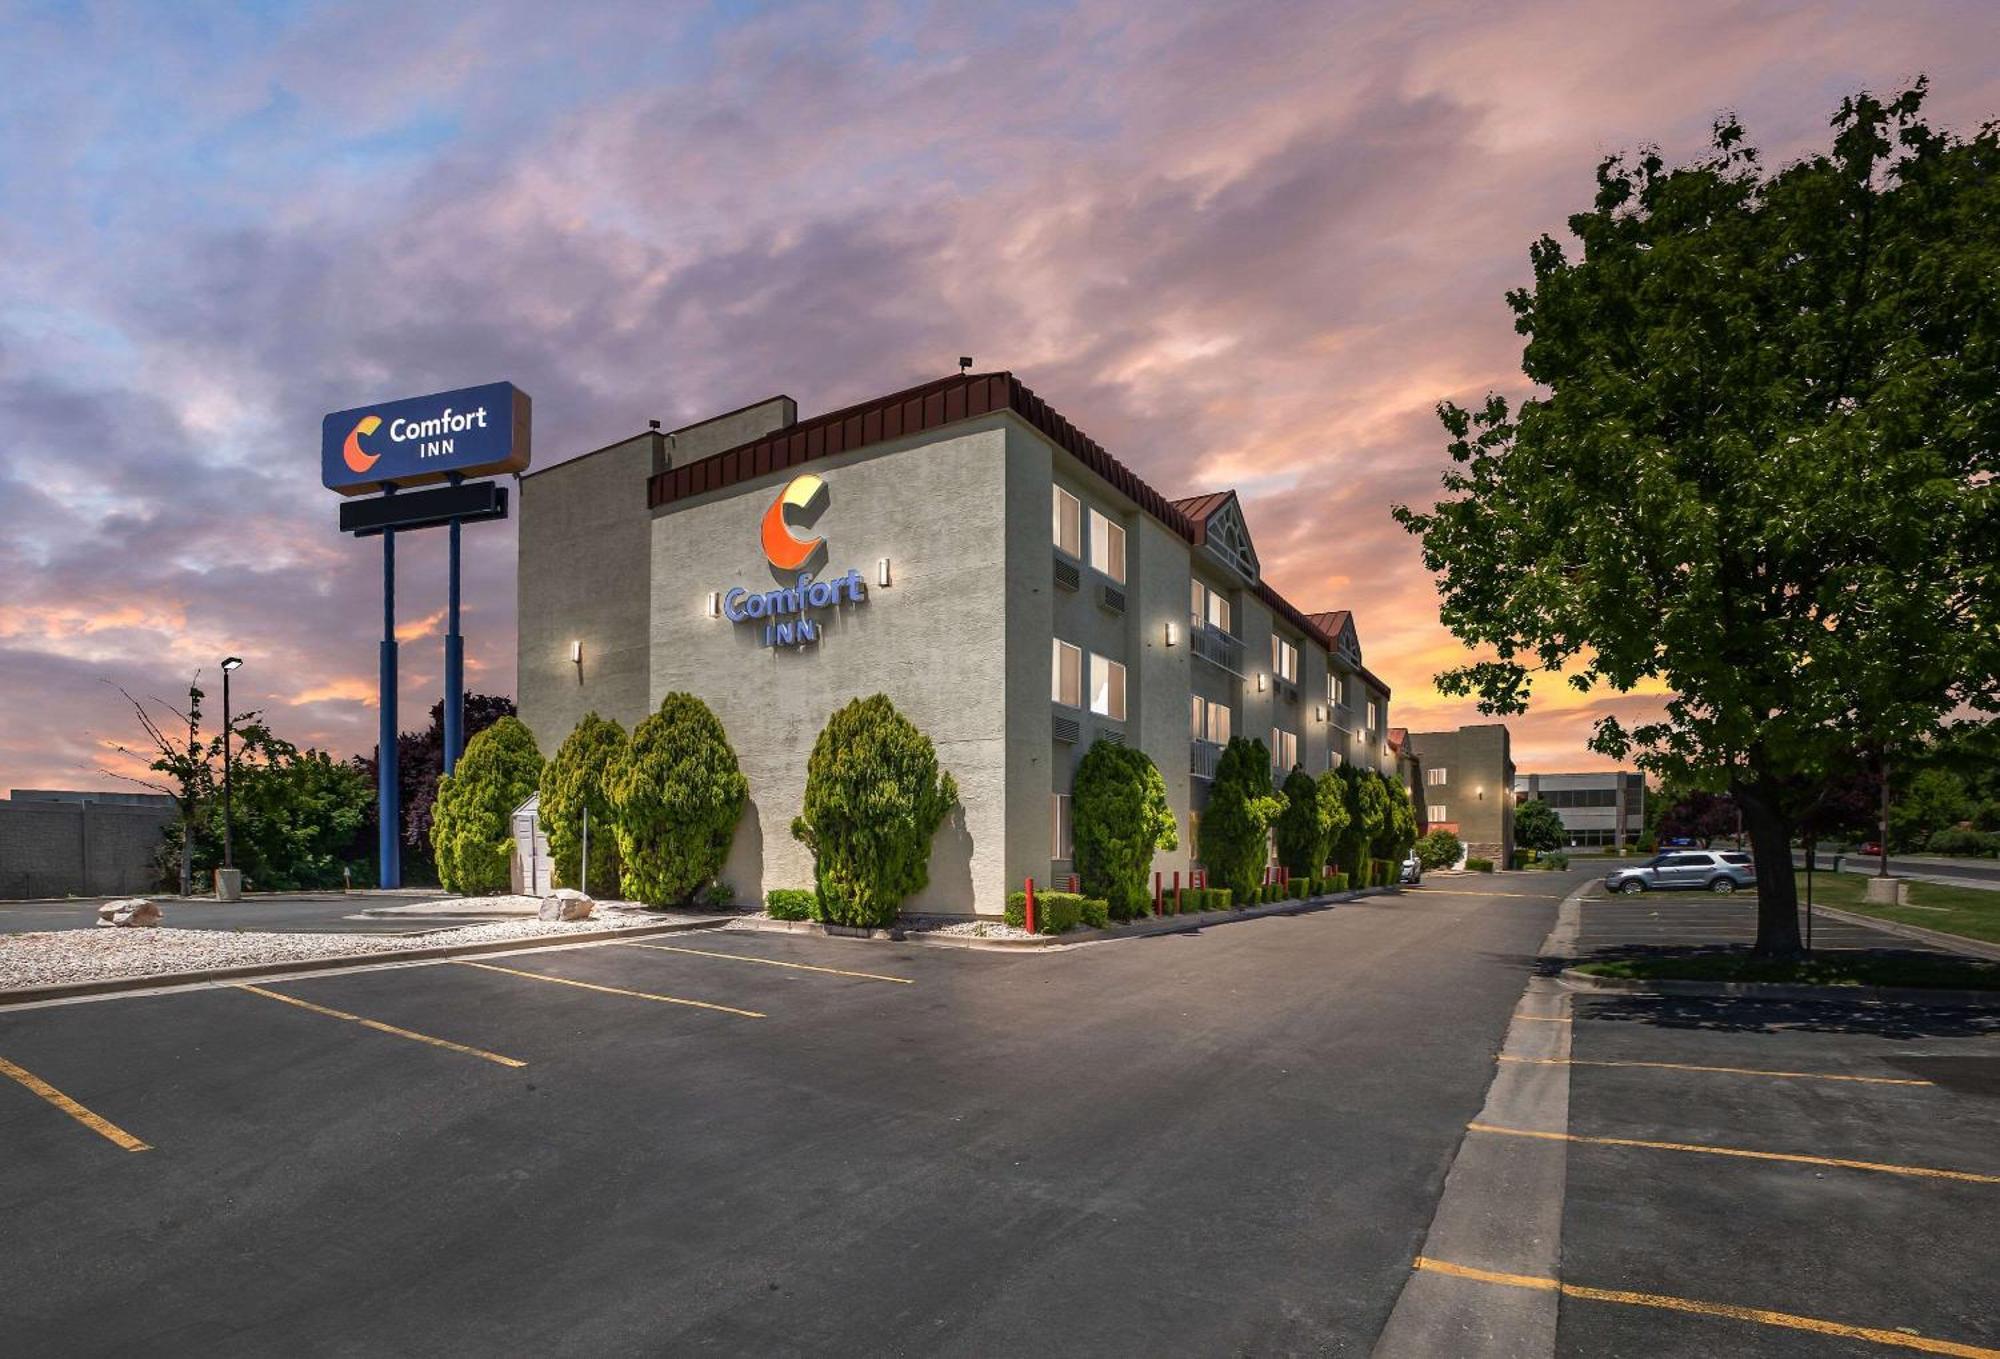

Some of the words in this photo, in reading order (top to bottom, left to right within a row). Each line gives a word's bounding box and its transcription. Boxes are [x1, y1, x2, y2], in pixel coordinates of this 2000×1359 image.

[390, 406, 487, 442] Comfort
[420, 438, 454, 458] INN
[724, 568, 865, 623] Comfort
[766, 618, 816, 646] INN
